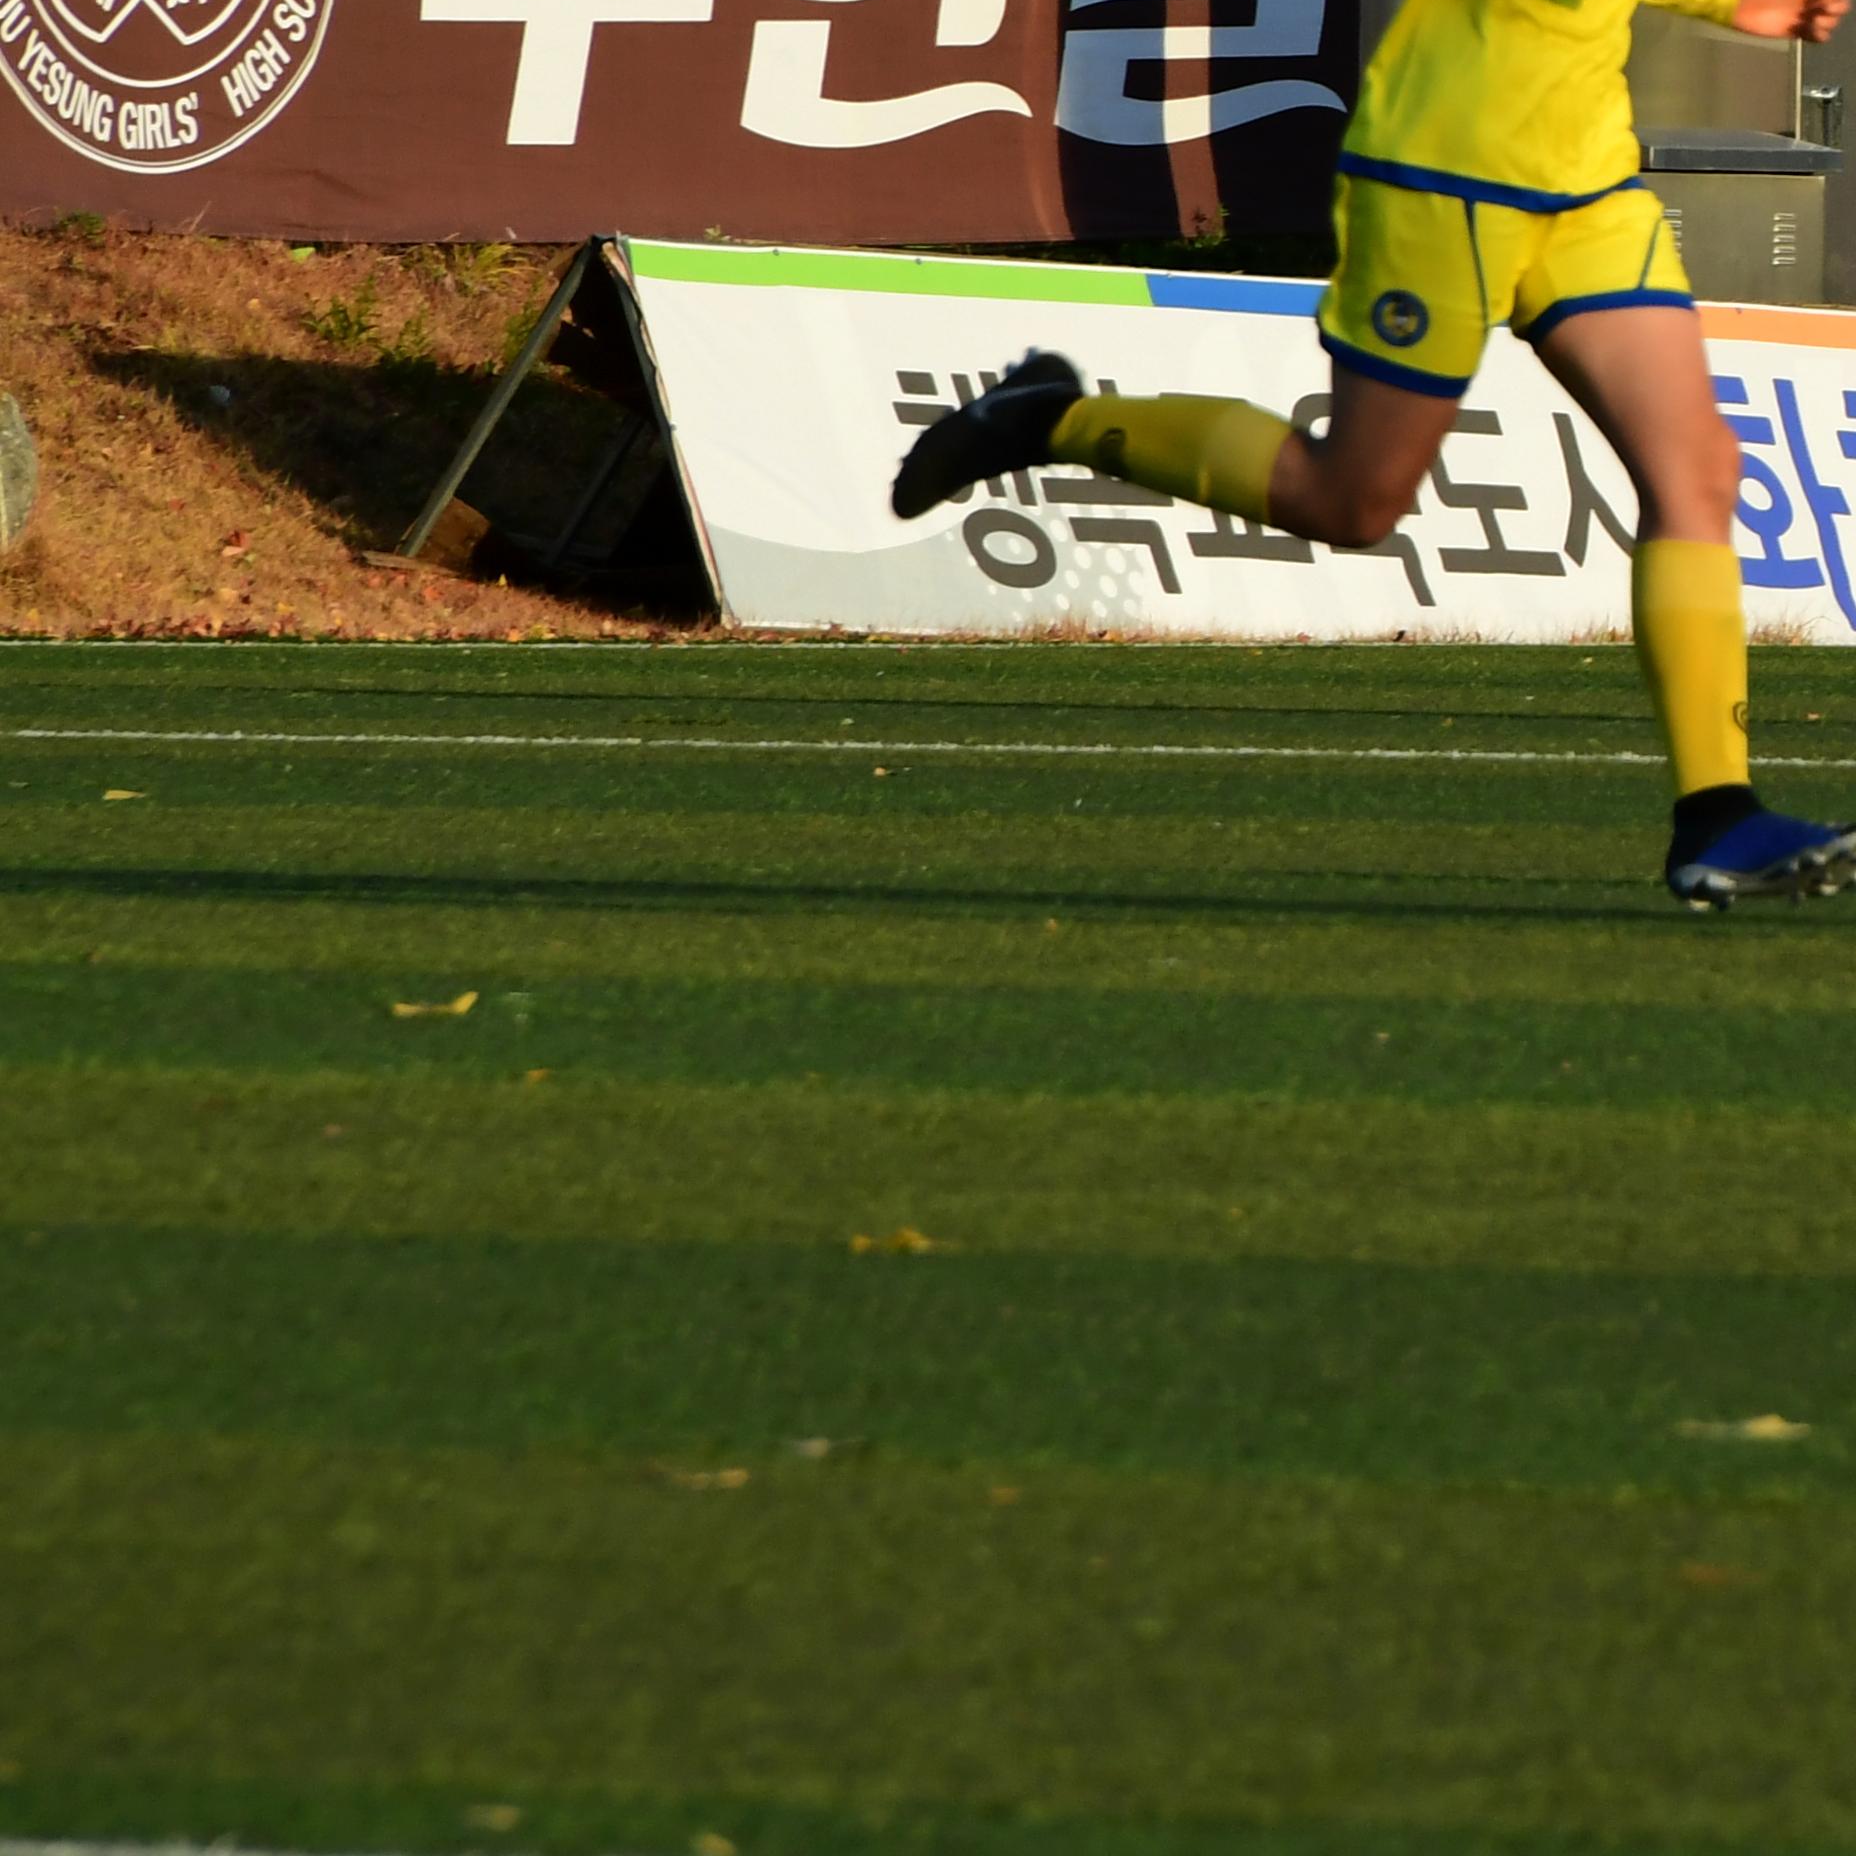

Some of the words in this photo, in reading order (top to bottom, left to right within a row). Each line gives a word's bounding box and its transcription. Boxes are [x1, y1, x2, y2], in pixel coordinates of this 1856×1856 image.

[17, 28, 115, 142] YESUNG
[117, 91, 199, 150] GIRLS'
[220, 28, 291, 118] HIGH
